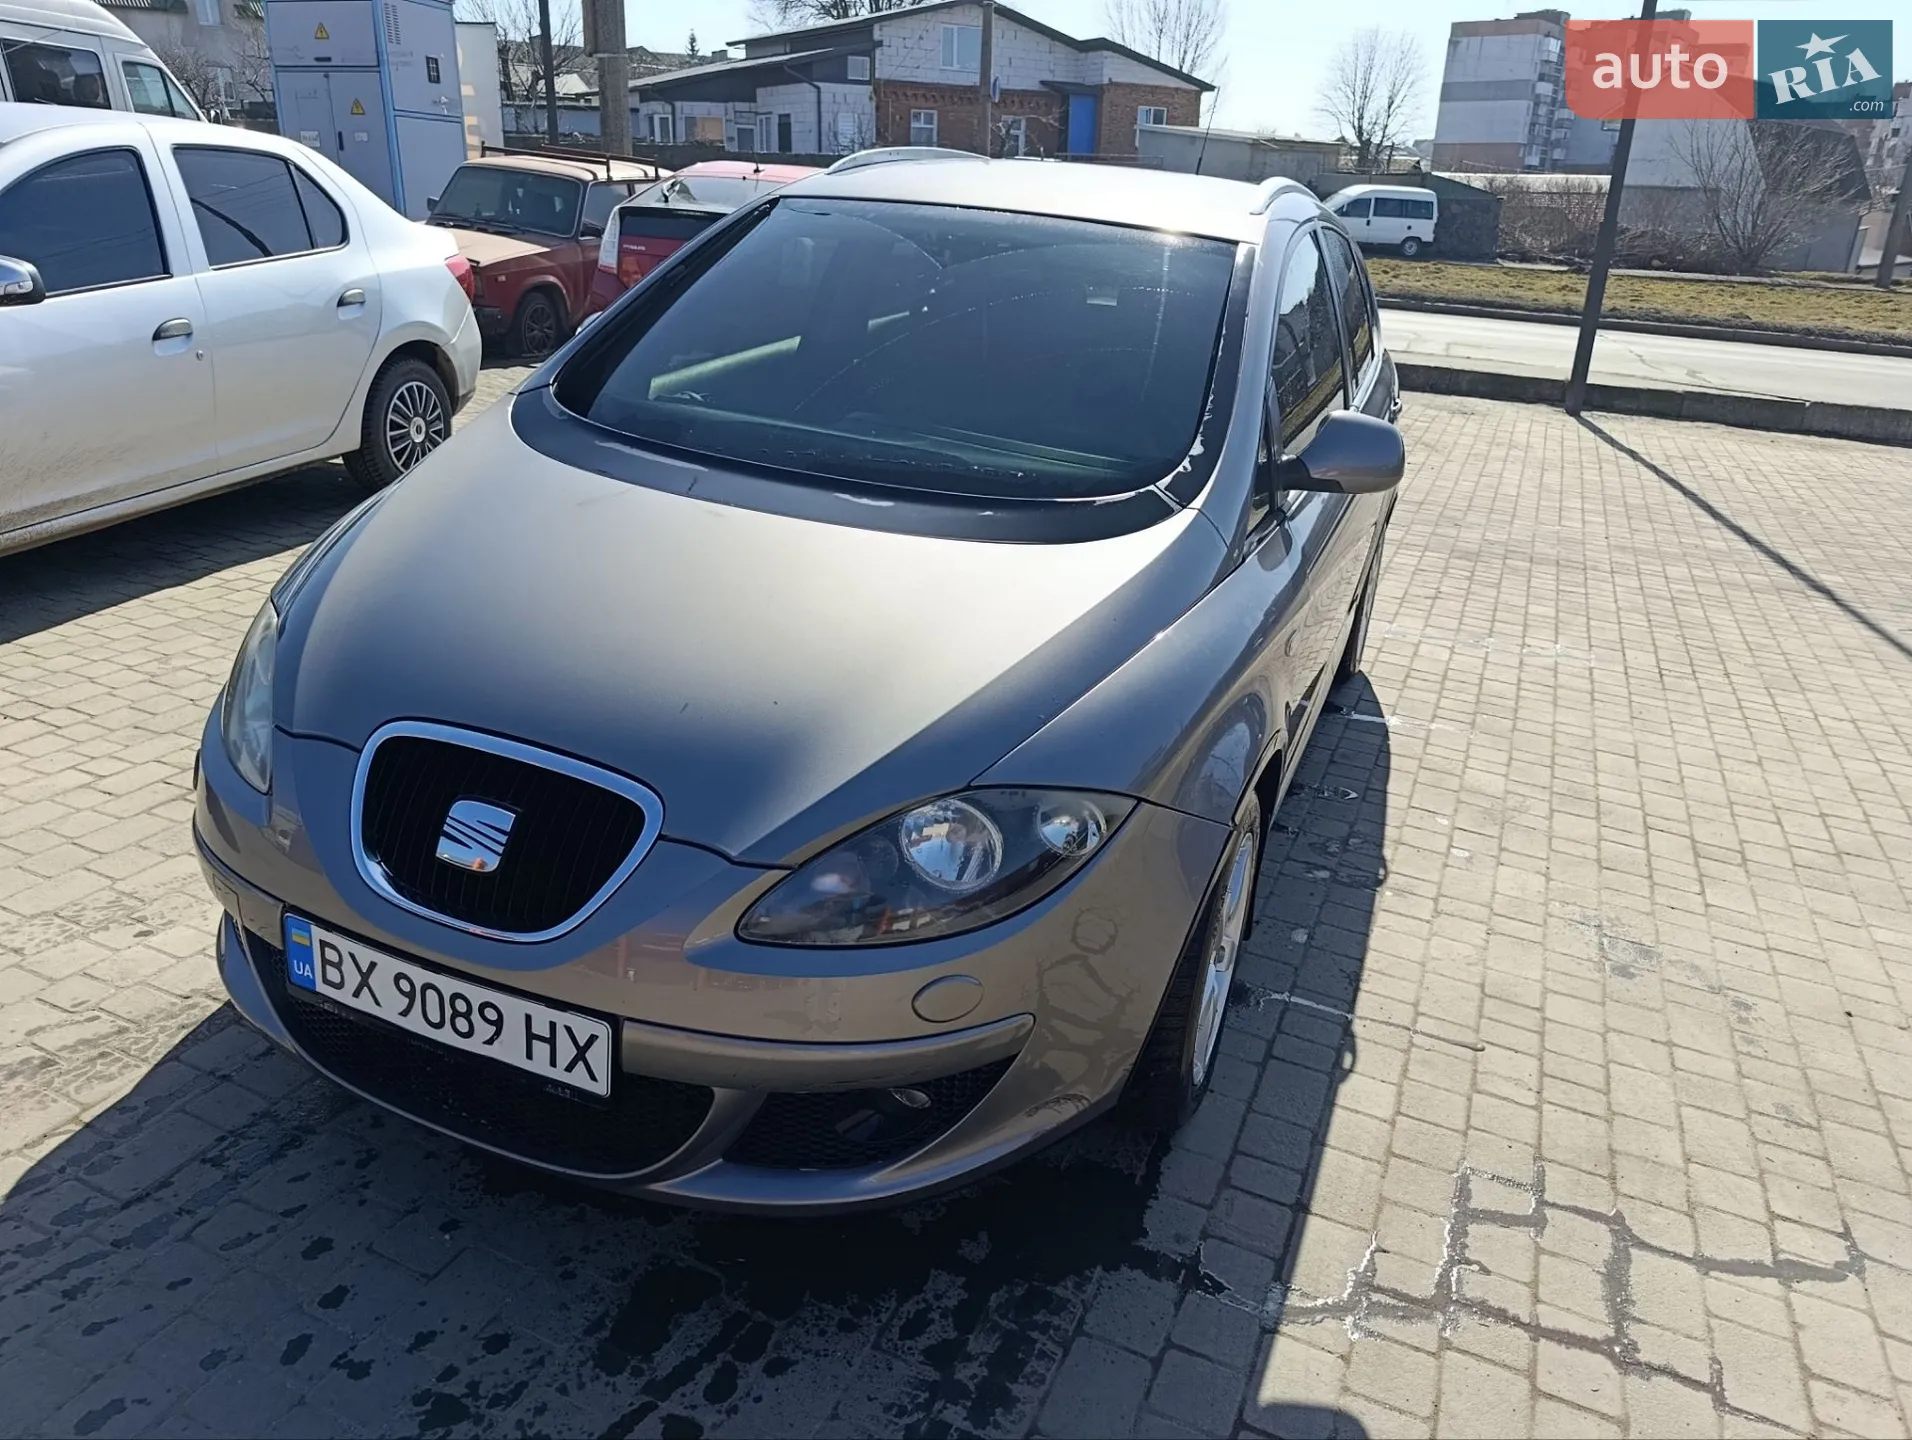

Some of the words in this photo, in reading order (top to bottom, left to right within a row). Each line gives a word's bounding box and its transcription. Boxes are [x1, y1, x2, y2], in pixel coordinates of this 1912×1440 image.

[293, 959, 314, 980] UA
[318, 938, 382, 1008] BX
[393, 971, 504, 1046] 9089
[524, 1012, 599, 1083] HX
